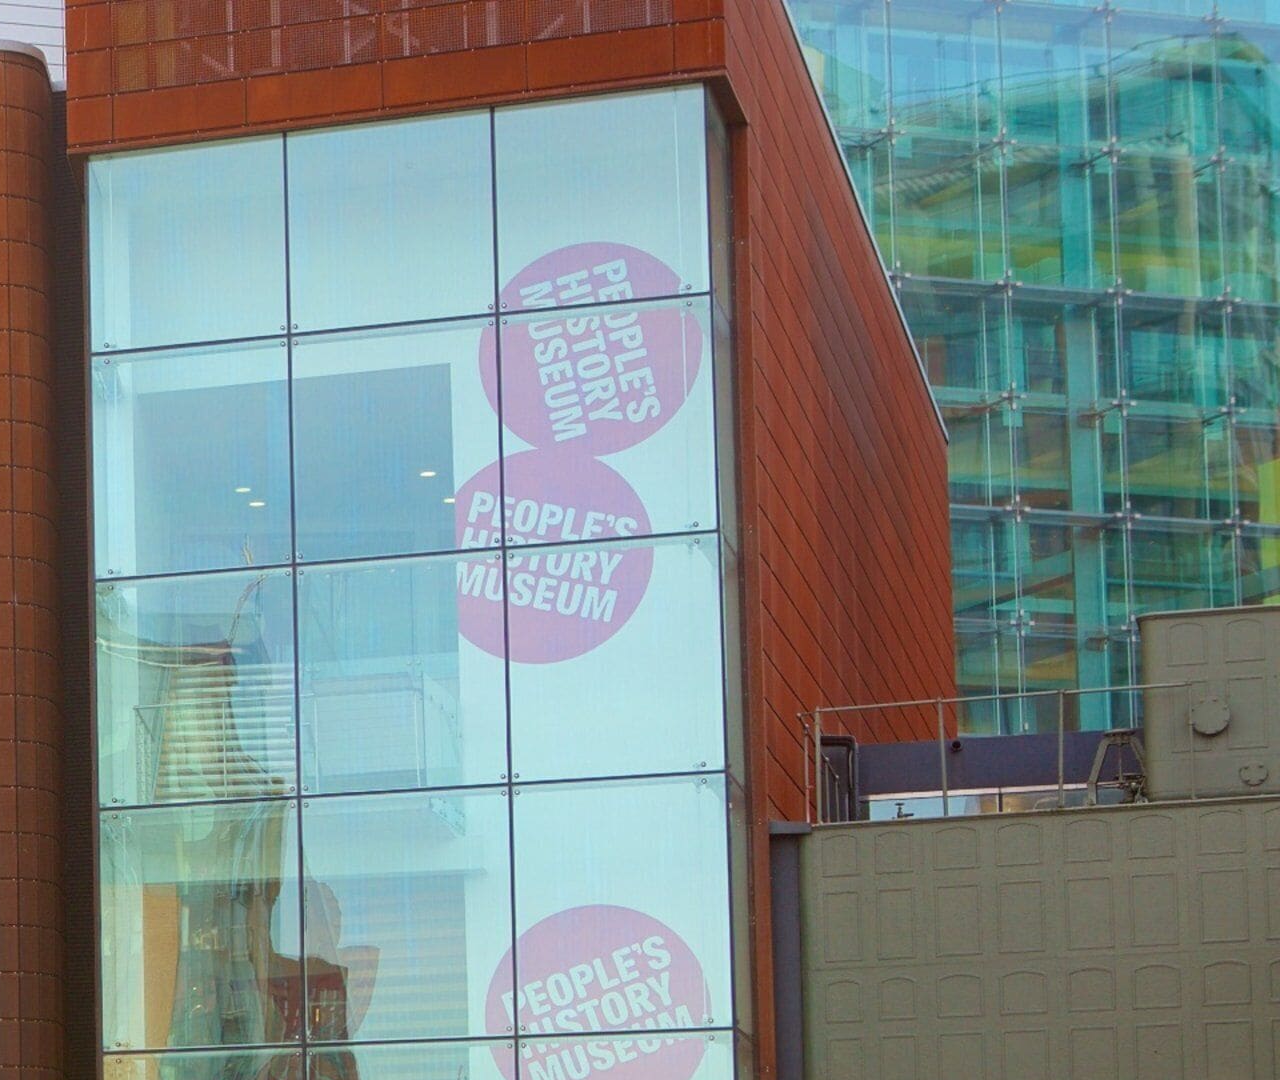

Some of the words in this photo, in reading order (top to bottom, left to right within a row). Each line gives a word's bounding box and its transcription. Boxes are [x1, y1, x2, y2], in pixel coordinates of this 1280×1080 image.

[519, 281, 587, 442] MUSEUM
[556, 269, 623, 421] HSTORY
[592, 258, 661, 423] PEOPLE'S
[467, 491, 638, 541] PEOPLE'S
[456, 561, 618, 622] MUSEUM
[501, 935, 672, 1027] PEOPLE'S
[522, 971, 673, 1059] HISTORY
